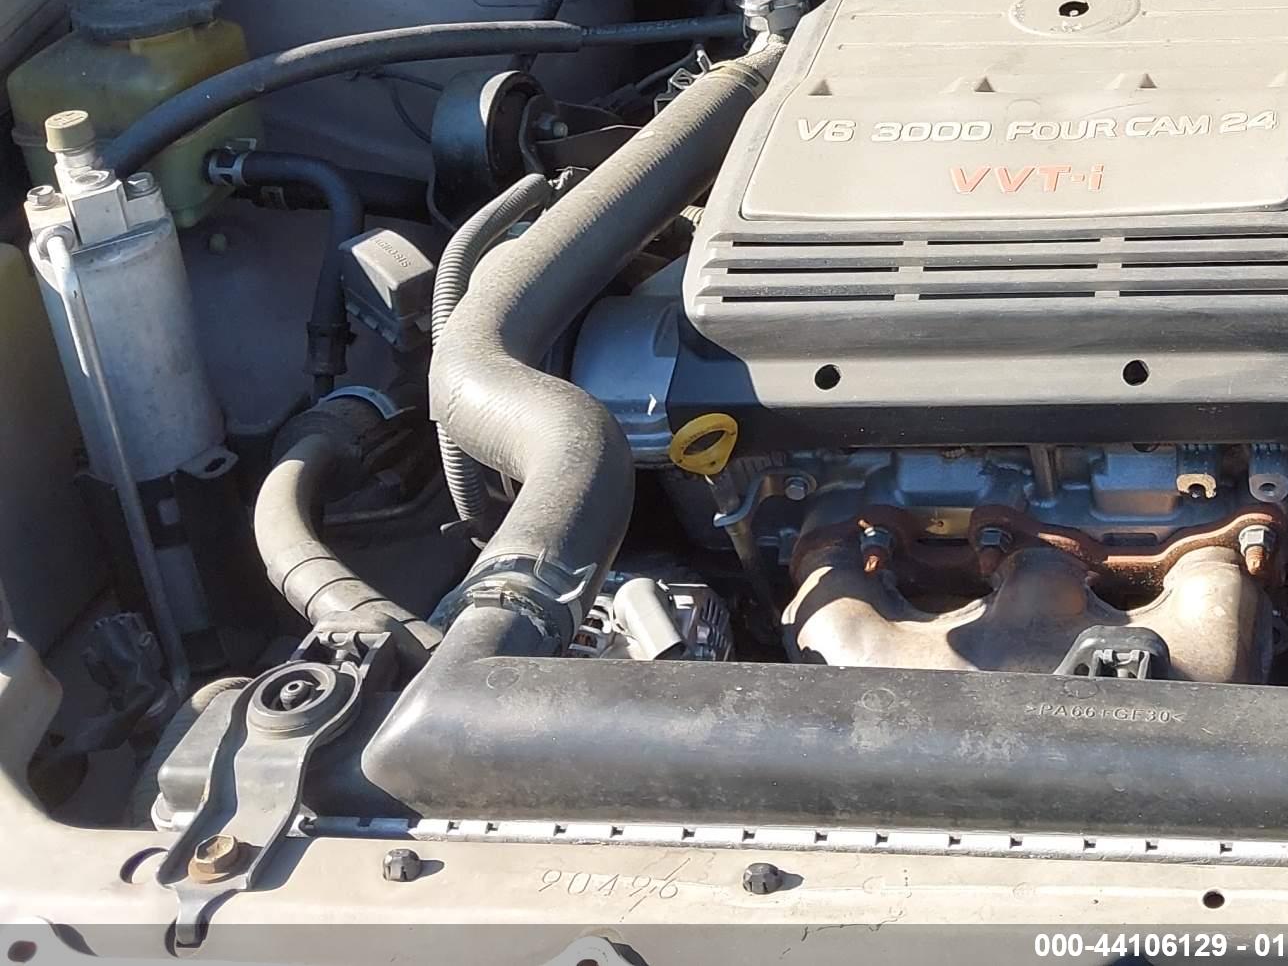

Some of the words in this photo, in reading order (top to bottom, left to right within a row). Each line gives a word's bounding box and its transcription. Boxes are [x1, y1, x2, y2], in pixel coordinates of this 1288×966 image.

[797, 119, 857, 143] V6
[871, 120, 992, 143] 3000
[1006, 118, 1118, 143] FOUR
[1124, 115, 1212, 137] CAM
[1219, 111, 1279, 134] 24
[950, 163, 1104, 194] VVT-i
